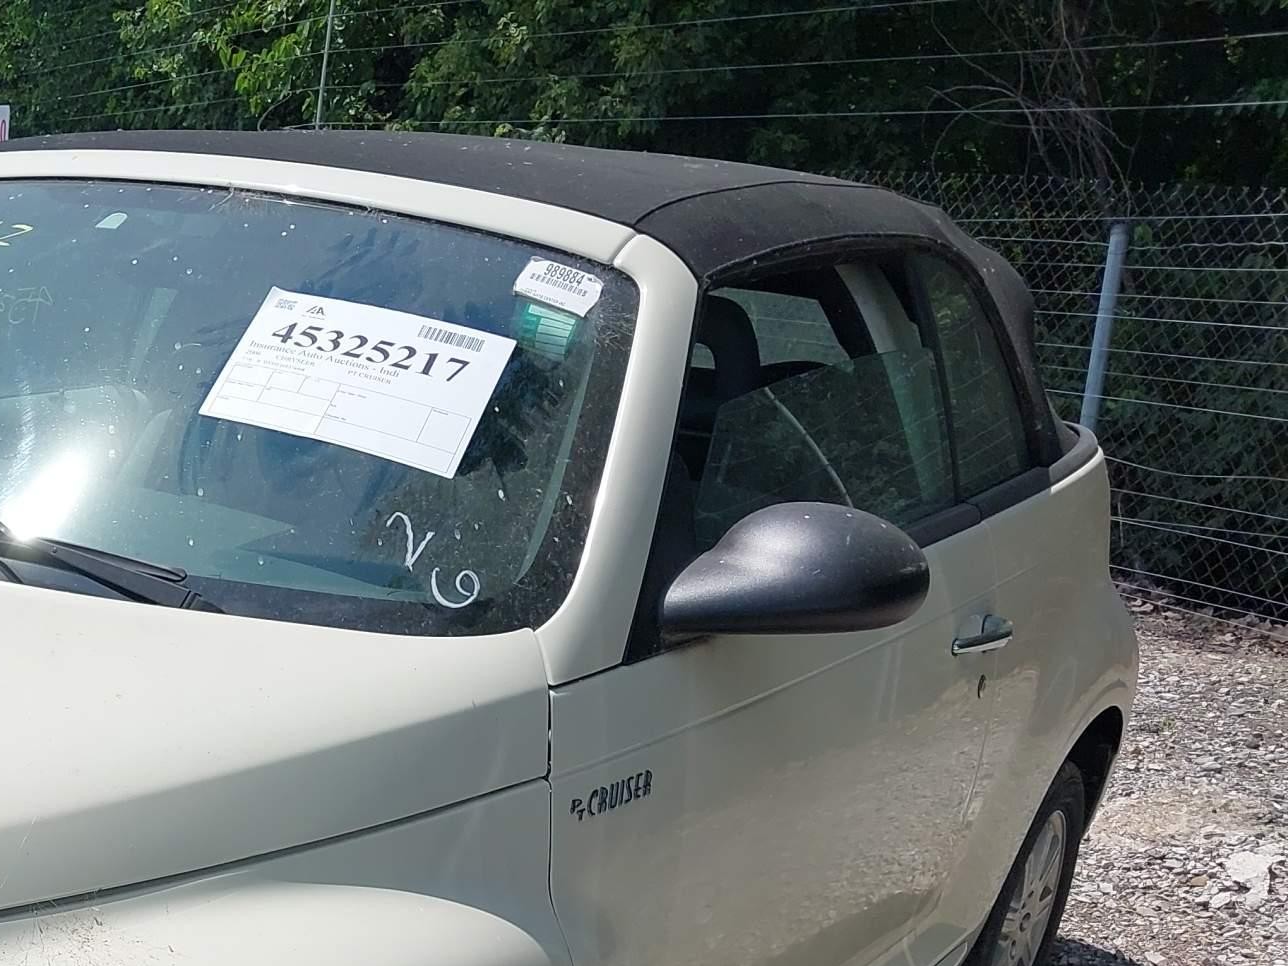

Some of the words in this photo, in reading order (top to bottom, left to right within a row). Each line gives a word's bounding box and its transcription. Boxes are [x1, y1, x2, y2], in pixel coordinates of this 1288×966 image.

[543, 263, 586, 287] 989884
[272, 322, 470, 383] 45325217
[298, 350, 324, 360] Auto
[325, 355, 369, 371] Auctions
[586, 770, 653, 817] CRUISER
